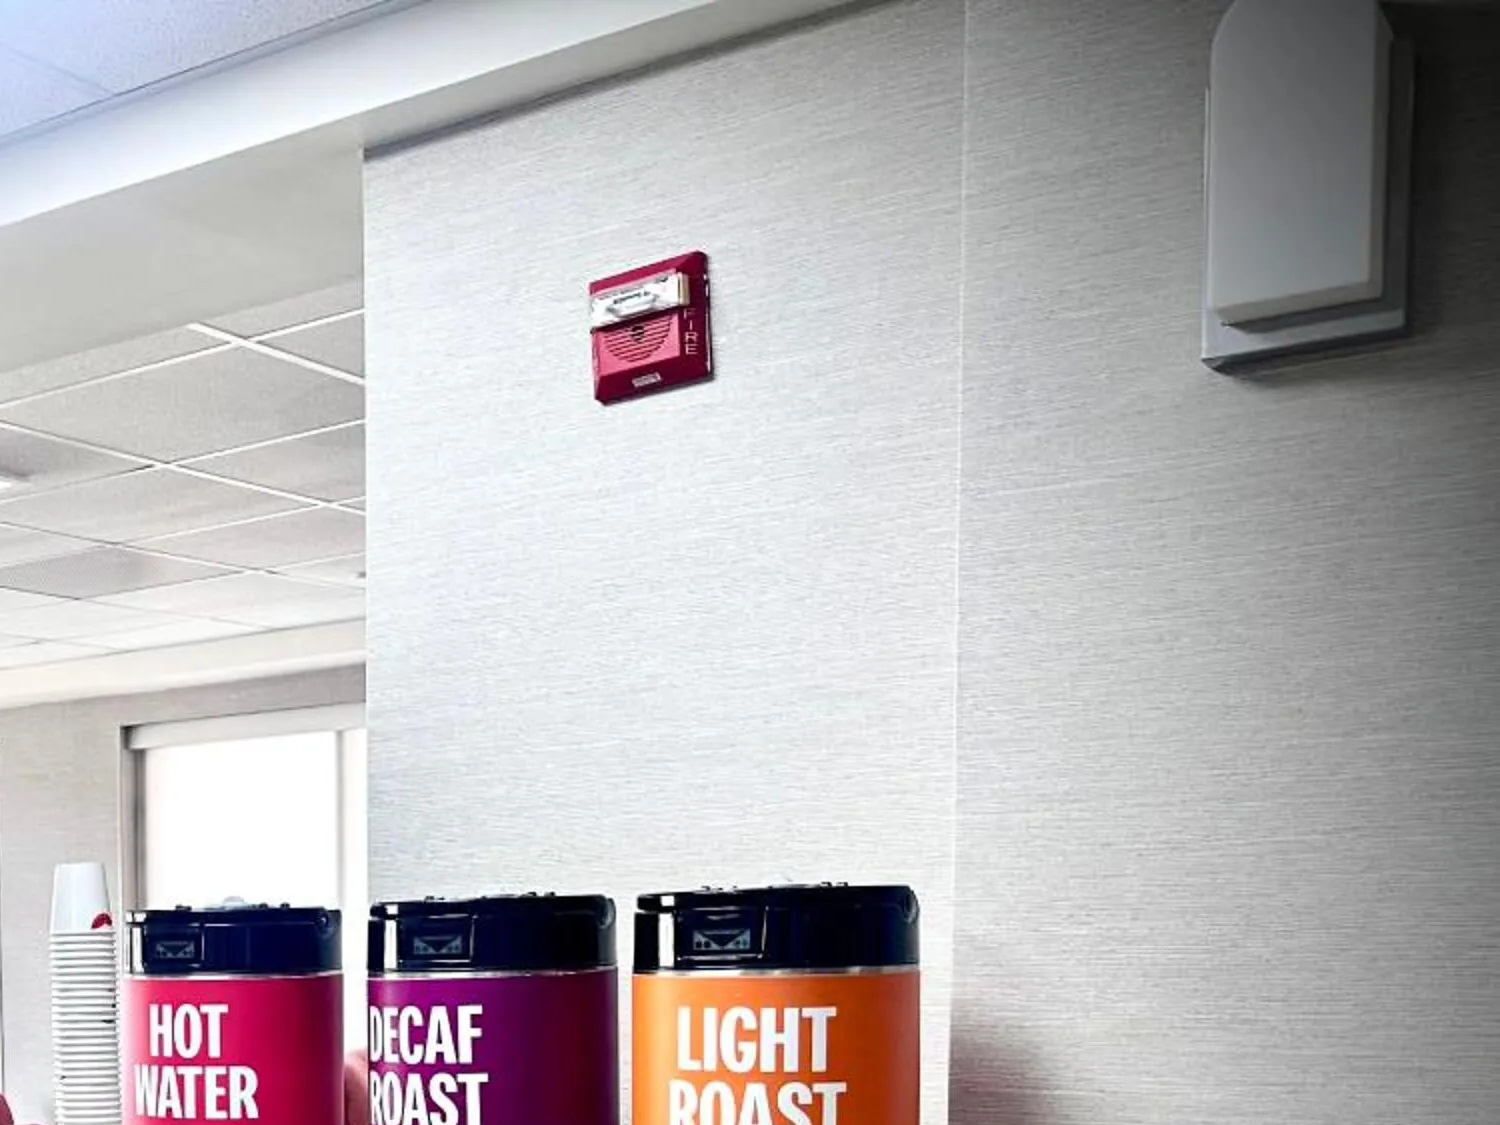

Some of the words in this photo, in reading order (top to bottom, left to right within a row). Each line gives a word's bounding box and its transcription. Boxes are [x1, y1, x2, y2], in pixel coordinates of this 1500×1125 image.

[683, 307, 699, 355] FIRE
[149, 1003, 229, 1059] HOT
[369, 1004, 483, 1065] DECAF
[677, 1006, 837, 1073] LIGHT
[133, 1063, 260, 1120] WATER
